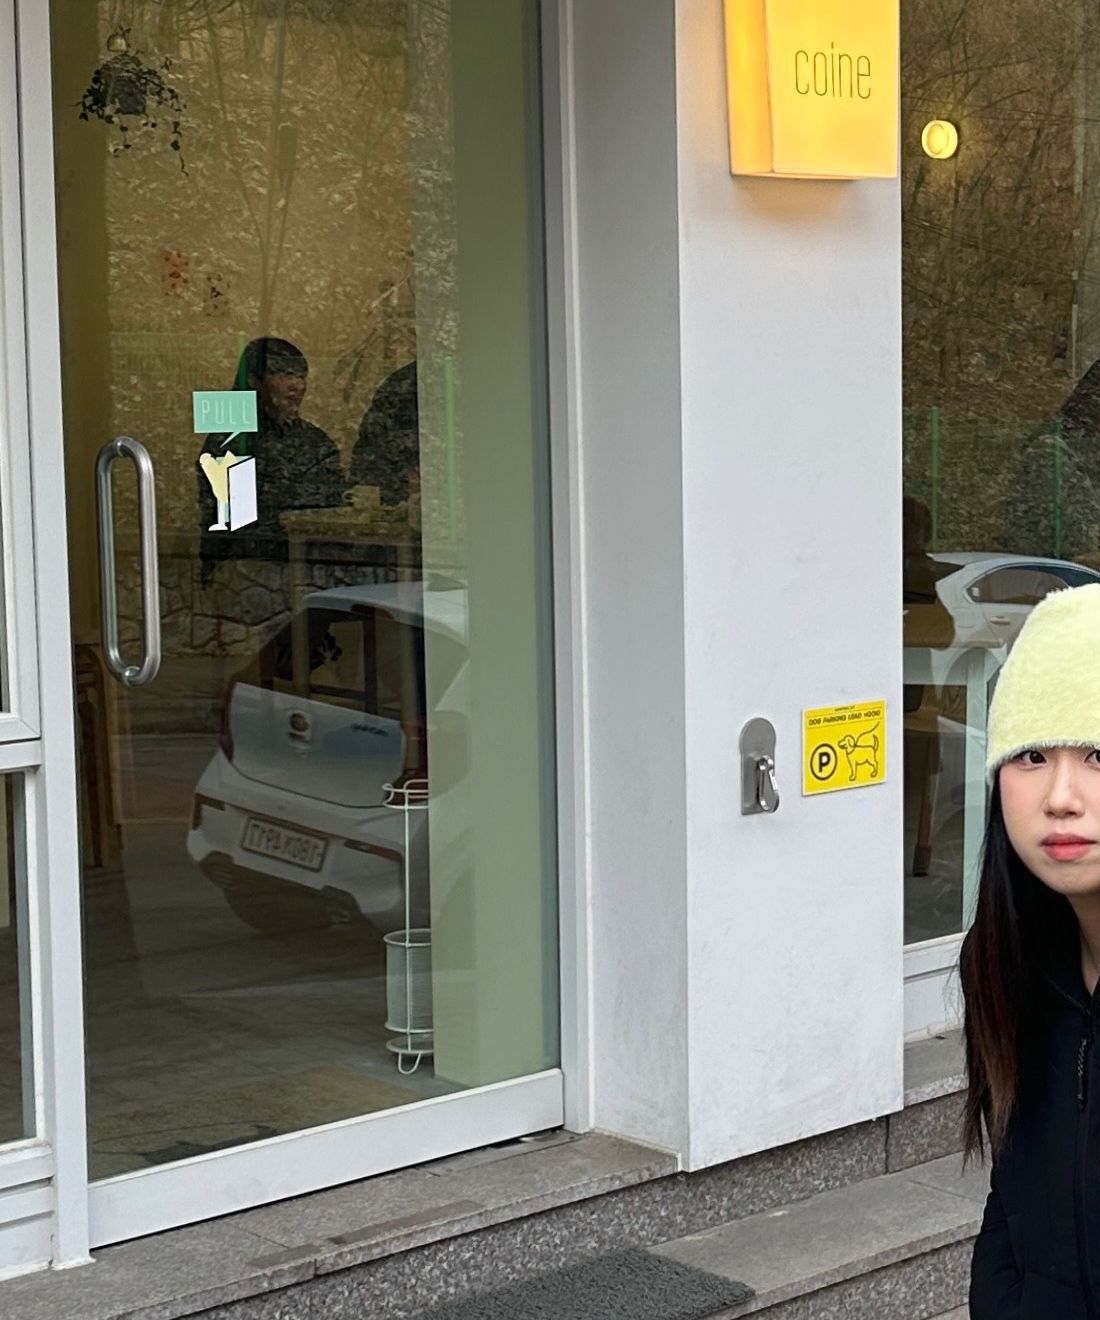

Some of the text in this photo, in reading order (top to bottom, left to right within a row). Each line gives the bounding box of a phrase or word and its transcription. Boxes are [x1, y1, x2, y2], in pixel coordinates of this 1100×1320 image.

[795, 41, 871, 99] coine
[202, 399, 253, 425] PULL
[818, 751, 831, 773] P
